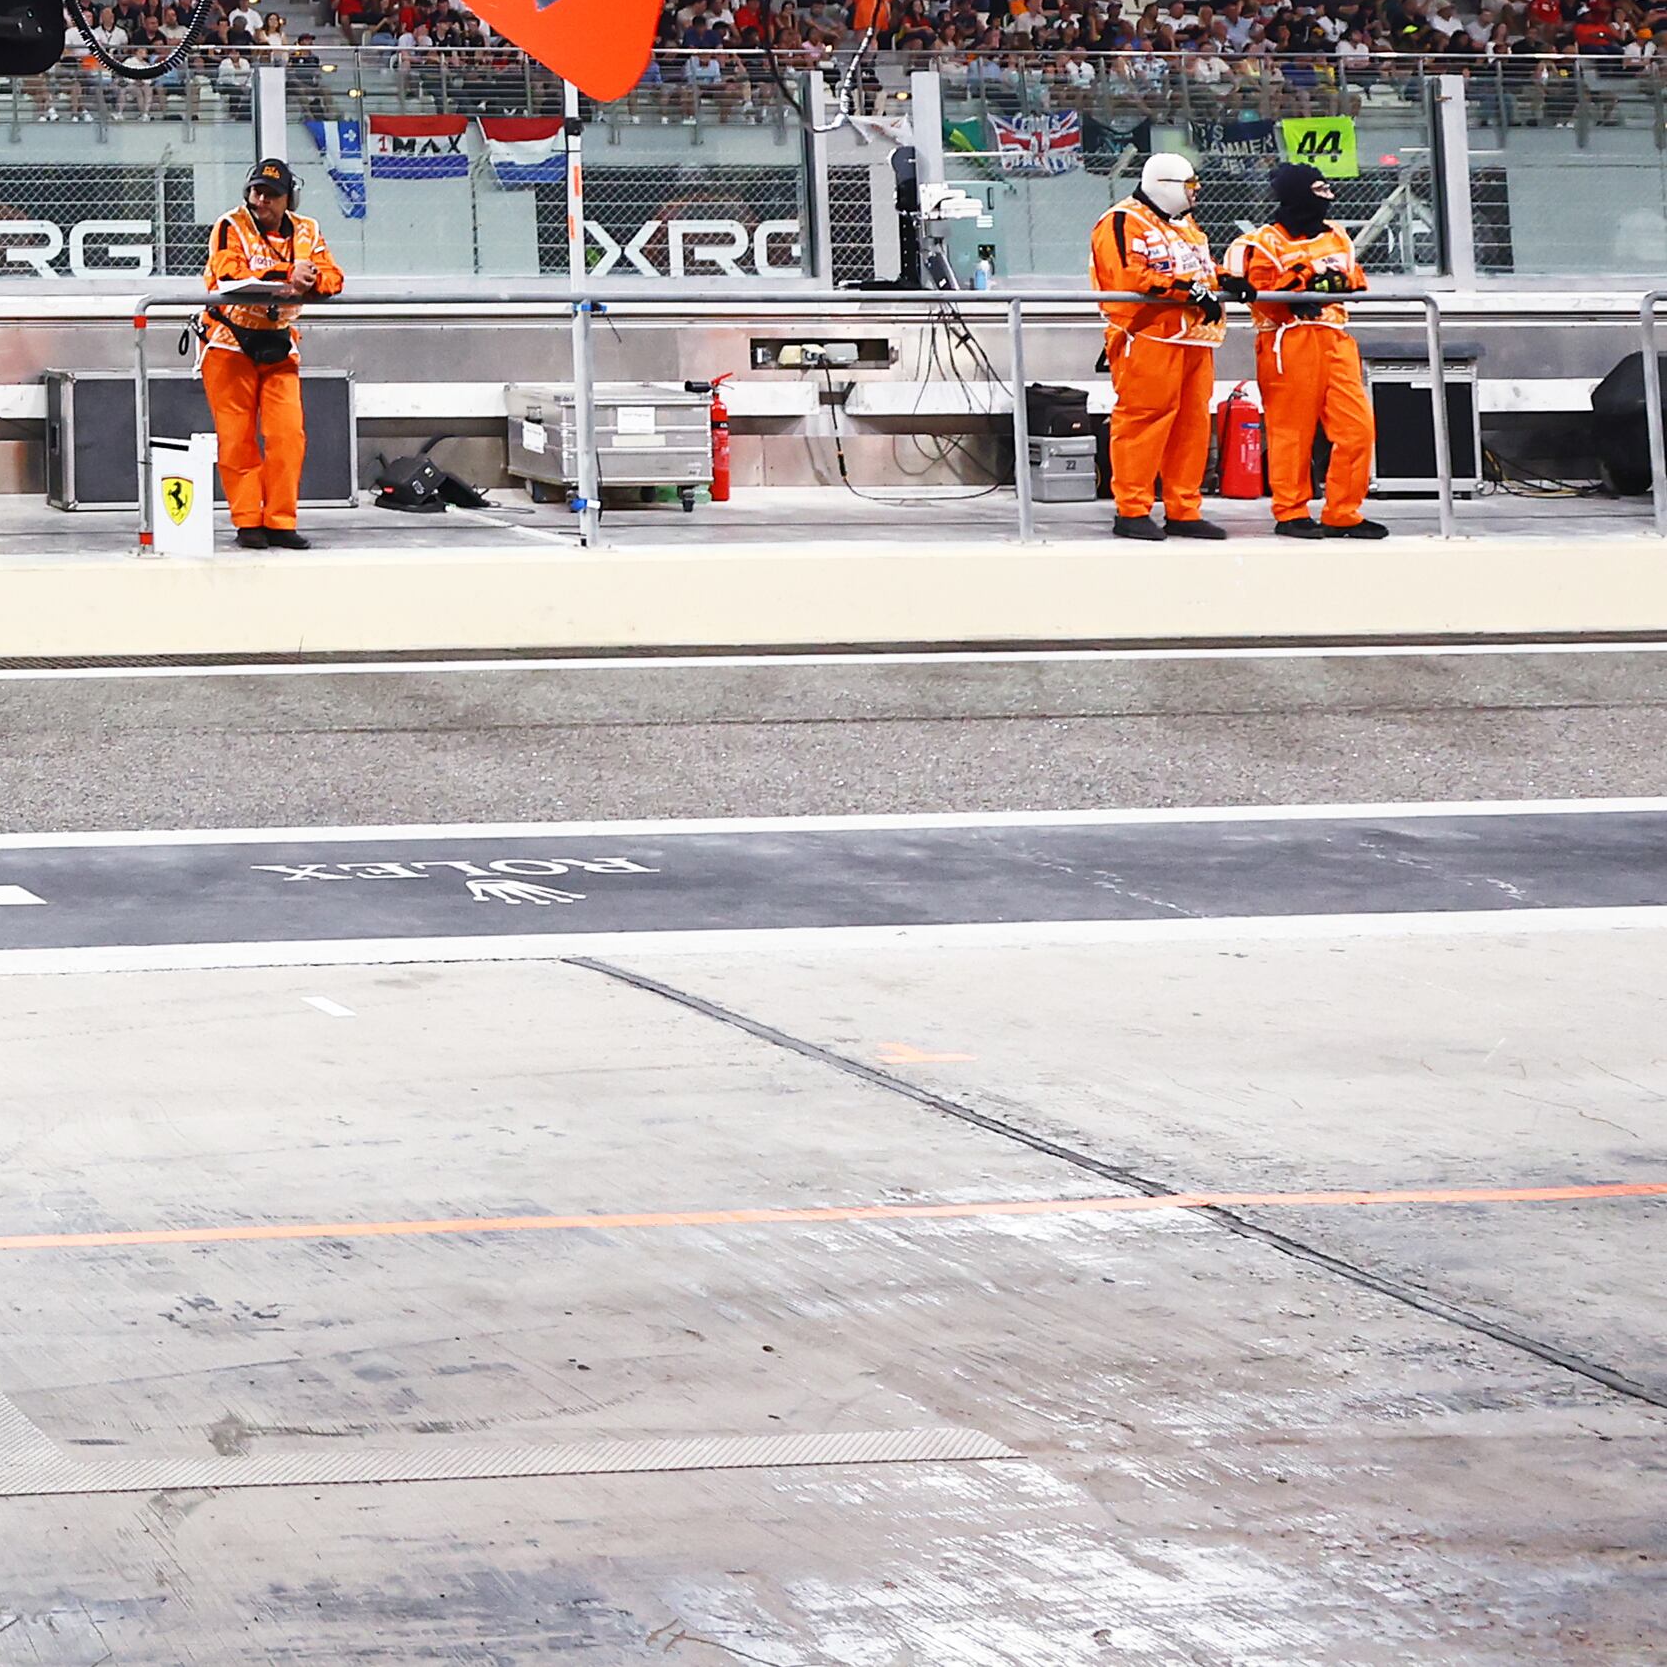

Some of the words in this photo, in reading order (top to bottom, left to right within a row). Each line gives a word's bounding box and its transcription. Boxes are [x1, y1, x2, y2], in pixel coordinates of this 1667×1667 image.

[393, 134, 463, 154] MAX
[1297, 130, 1343, 163] 44
[251, 857, 660, 881] ROLEX
